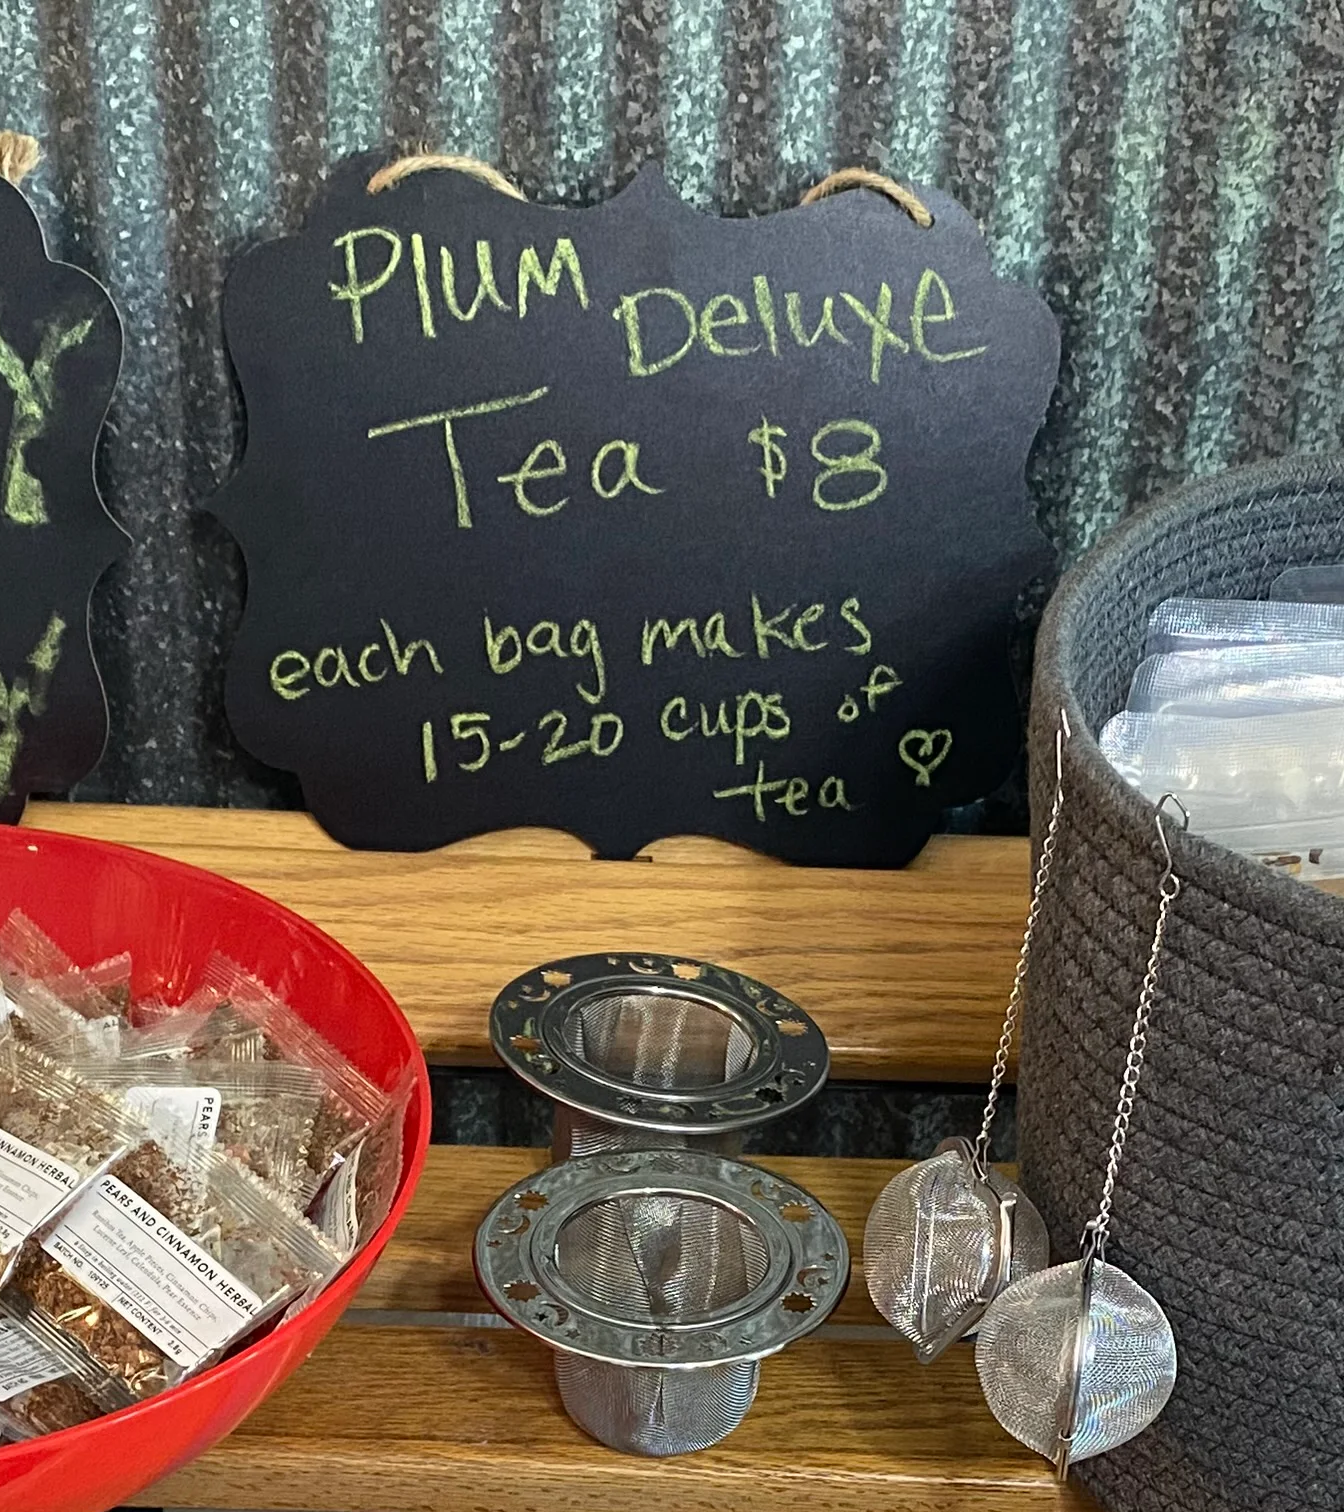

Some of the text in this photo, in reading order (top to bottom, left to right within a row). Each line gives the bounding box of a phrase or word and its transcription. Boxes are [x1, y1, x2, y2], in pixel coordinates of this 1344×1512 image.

[612, 267, 988, 383] Deluxe
[368, 386, 889, 527] Tea $8
[270, 594, 873, 703] each bag makes
[425, 664, 903, 784] 15-20 cups of
[713, 760, 852, 822] tea
[38, 1162, 76, 1190] HERBAL
[53, 1241, 182, 1356] BATCH NO. 109125 NET CONTENT 2.8g
[100, 1180, 258, 1316] PEARS AND CINNAMON HERBAL
[162, 1283, 177, 1299] Pear
[165, 1273, 198, 1306] Cinnamon
